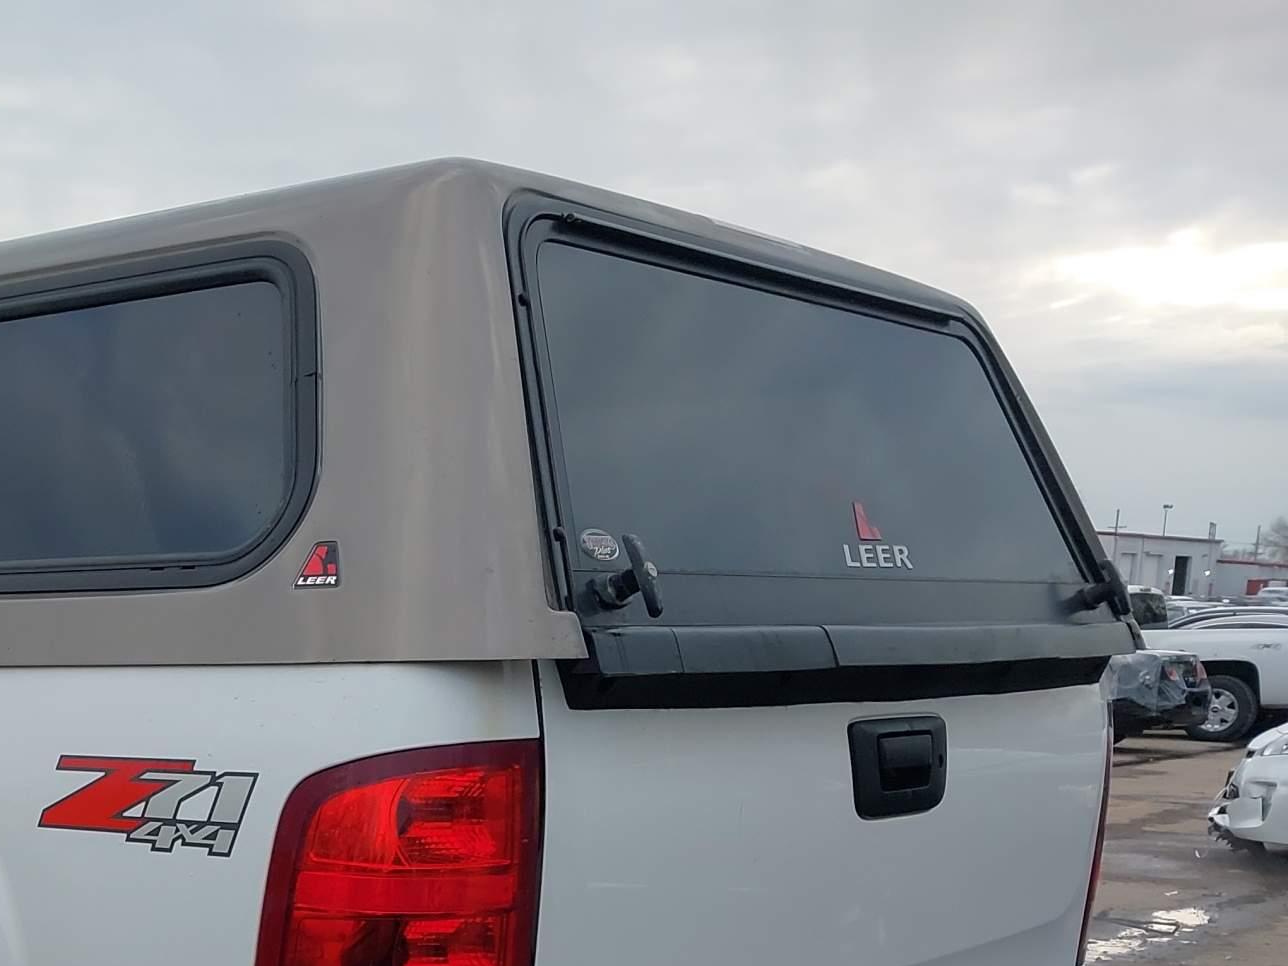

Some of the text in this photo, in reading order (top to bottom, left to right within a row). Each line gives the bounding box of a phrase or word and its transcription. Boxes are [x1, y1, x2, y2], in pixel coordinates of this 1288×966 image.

[842, 543, 914, 570] LEER
[297, 575, 337, 585] LEER
[37, 754, 259, 834] Z71
